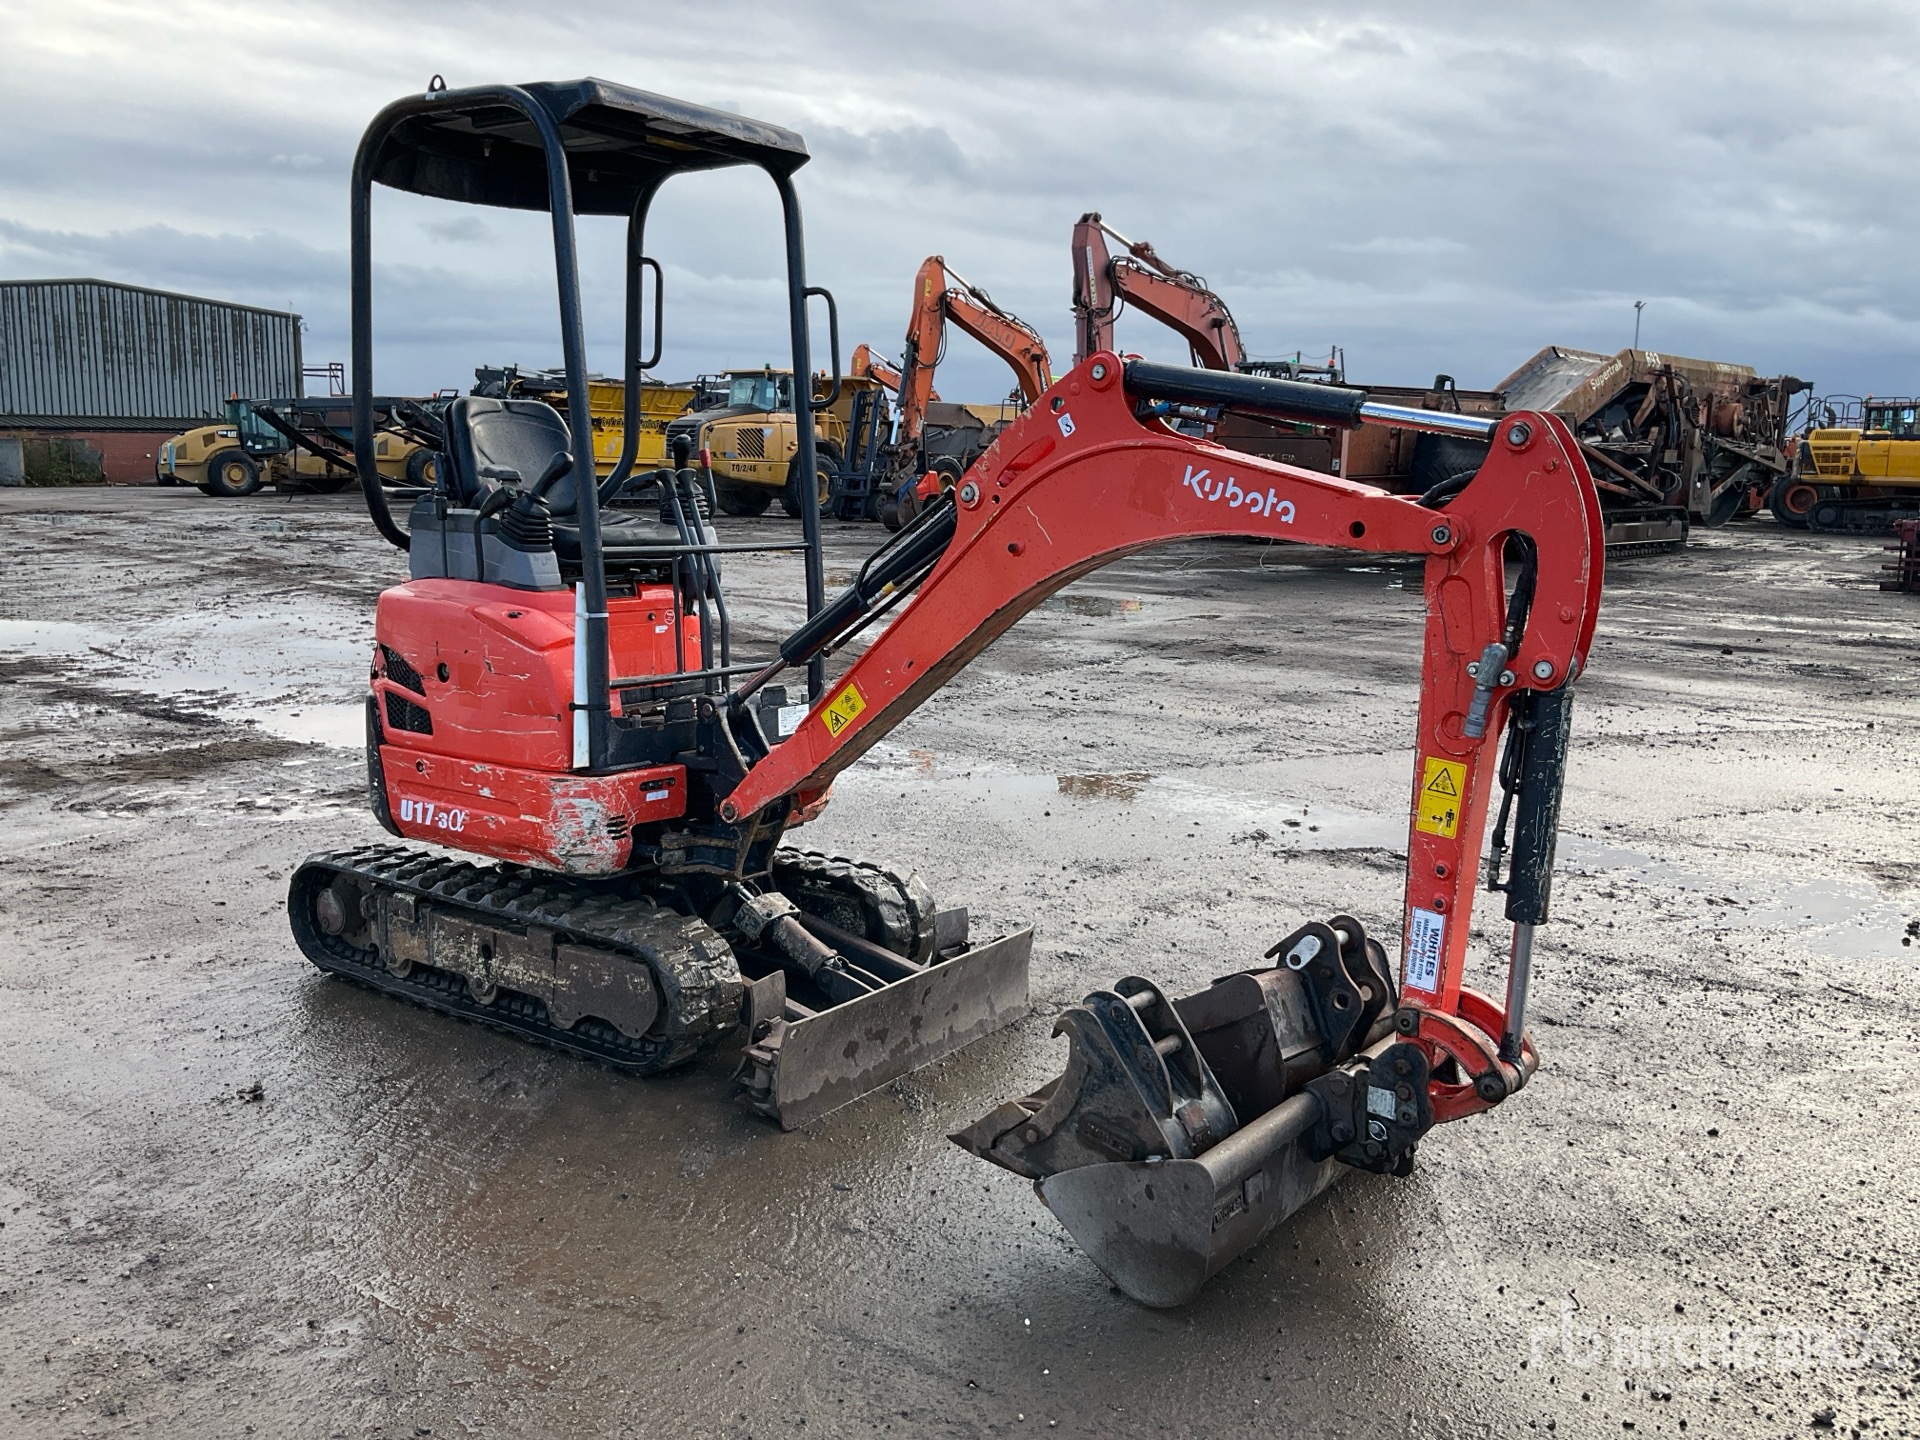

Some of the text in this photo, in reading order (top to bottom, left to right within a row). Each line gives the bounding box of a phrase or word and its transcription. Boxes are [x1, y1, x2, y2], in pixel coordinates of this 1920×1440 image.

[1590, 358, 1624, 390] Supertrak
[732, 464, 757, 473] TQ/2/46
[1182, 464, 1296, 524] Kubota
[1425, 928, 1440, 976] WHITES
